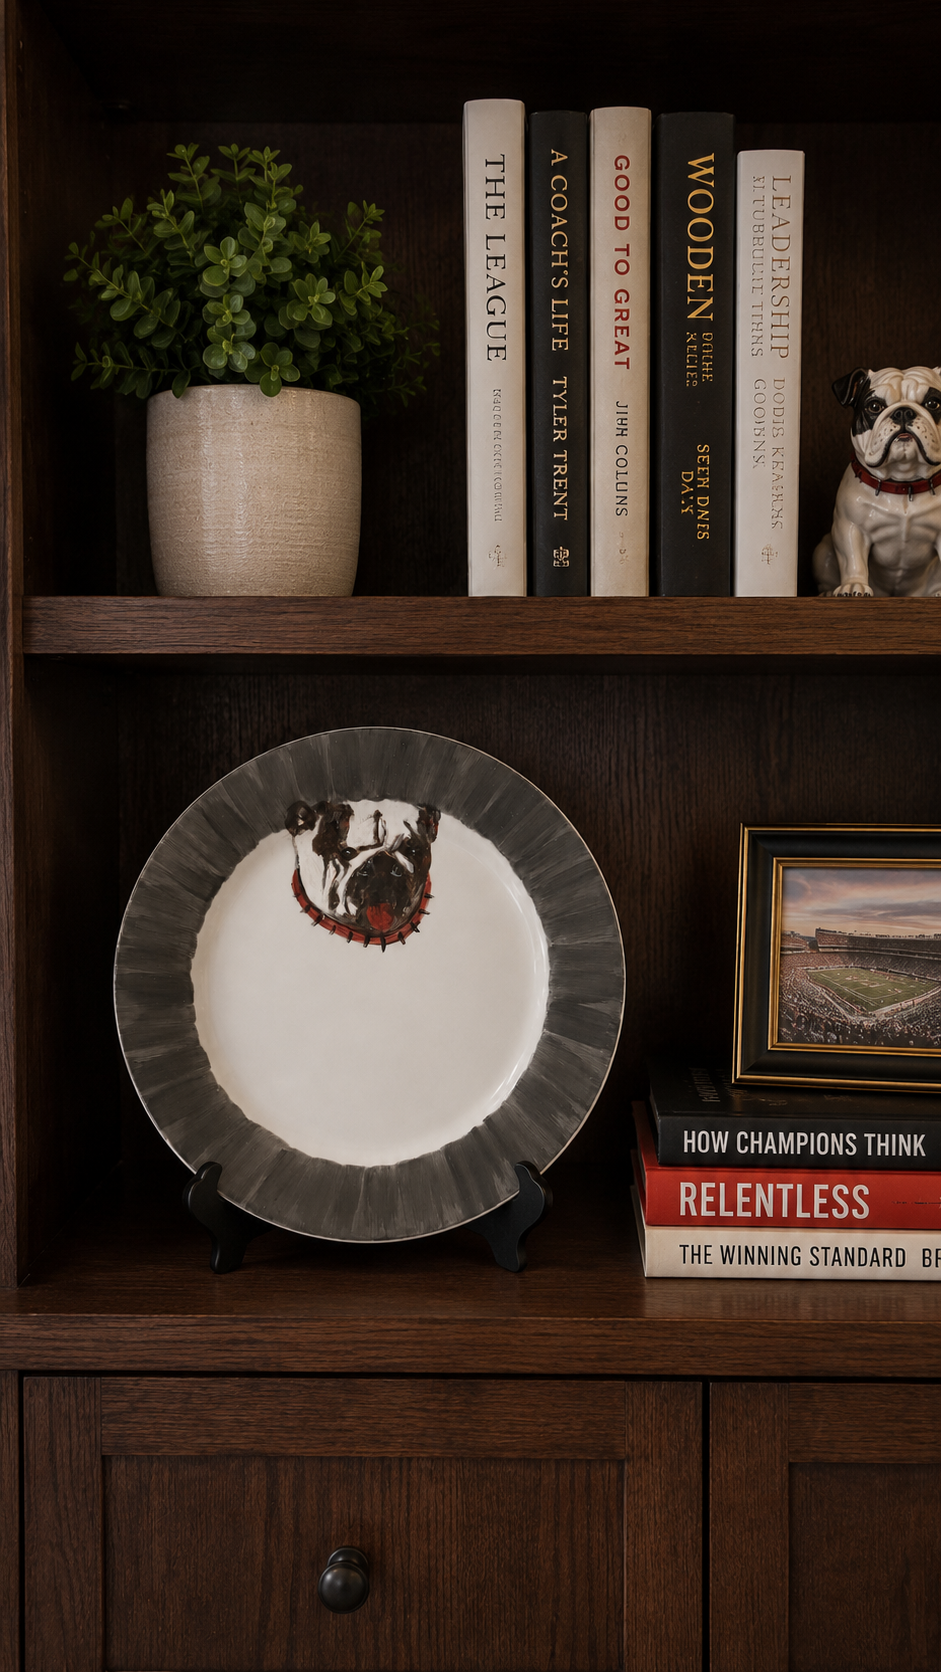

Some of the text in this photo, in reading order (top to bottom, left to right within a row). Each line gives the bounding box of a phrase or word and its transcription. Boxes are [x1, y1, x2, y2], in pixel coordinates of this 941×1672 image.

[484, 153, 507, 362] THE LEAGUE
[550, 148, 569, 352] A COACH'S LIFE
[613, 154, 631, 370] GOOD TO GREAT
[686, 152, 715, 321] WOODEN
[770, 174, 792, 359] LEADERSHIP
[552, 375, 568, 521] TYLER TRENT
[679, 1181, 870, 1220] RELENTLESS
[683, 1130, 926, 1157] HOW CHAMPIONS THINK
[678, 1244, 713, 1265] THE
[719, 1244, 801, 1266] WINNING
[809, 1246, 906, 1268] STANDARD
